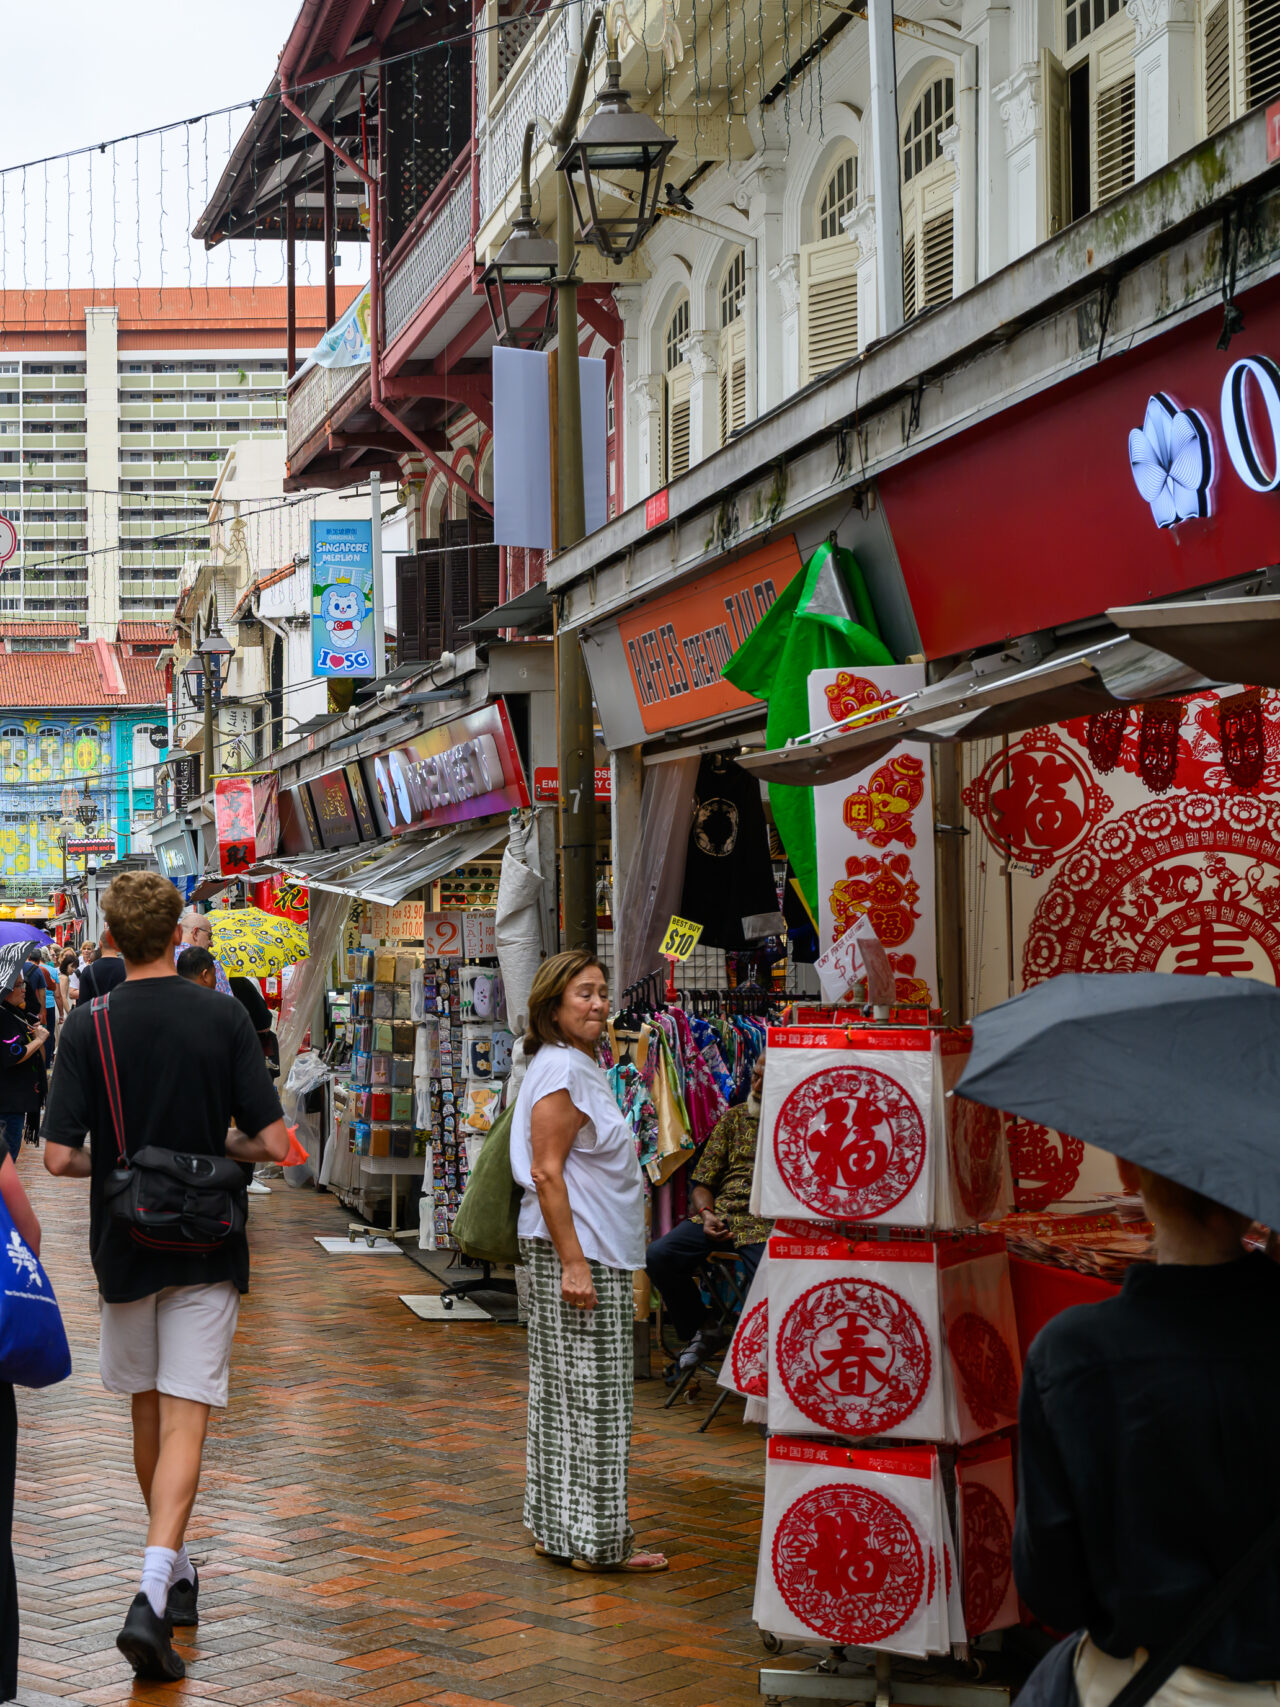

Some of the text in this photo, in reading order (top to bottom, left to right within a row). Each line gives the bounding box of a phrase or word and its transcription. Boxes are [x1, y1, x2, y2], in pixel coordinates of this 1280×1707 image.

[323, 554, 360, 562] MERLION
[344, 651, 369, 670] SG
[627, 622, 690, 707] RAFFLES
[569, 789, 580, 814] 7
[392, 910, 401, 919] FOR
[404, 904, 423, 919] $3.90
[671, 917, 701, 933] BEST BUY
[426, 921, 459, 955] $2
[665, 928, 695, 957] $10
[775, 1033, 828, 1046] 中国剪纸
[808, 1097, 888, 1188] 福
[776, 1244, 829, 1257] 中国剪纸
[820, 1312, 889, 1394] 春
[776, 1444, 829, 1461] 中国剪纸
[803, 1493, 873, 1514] 幸福平安
